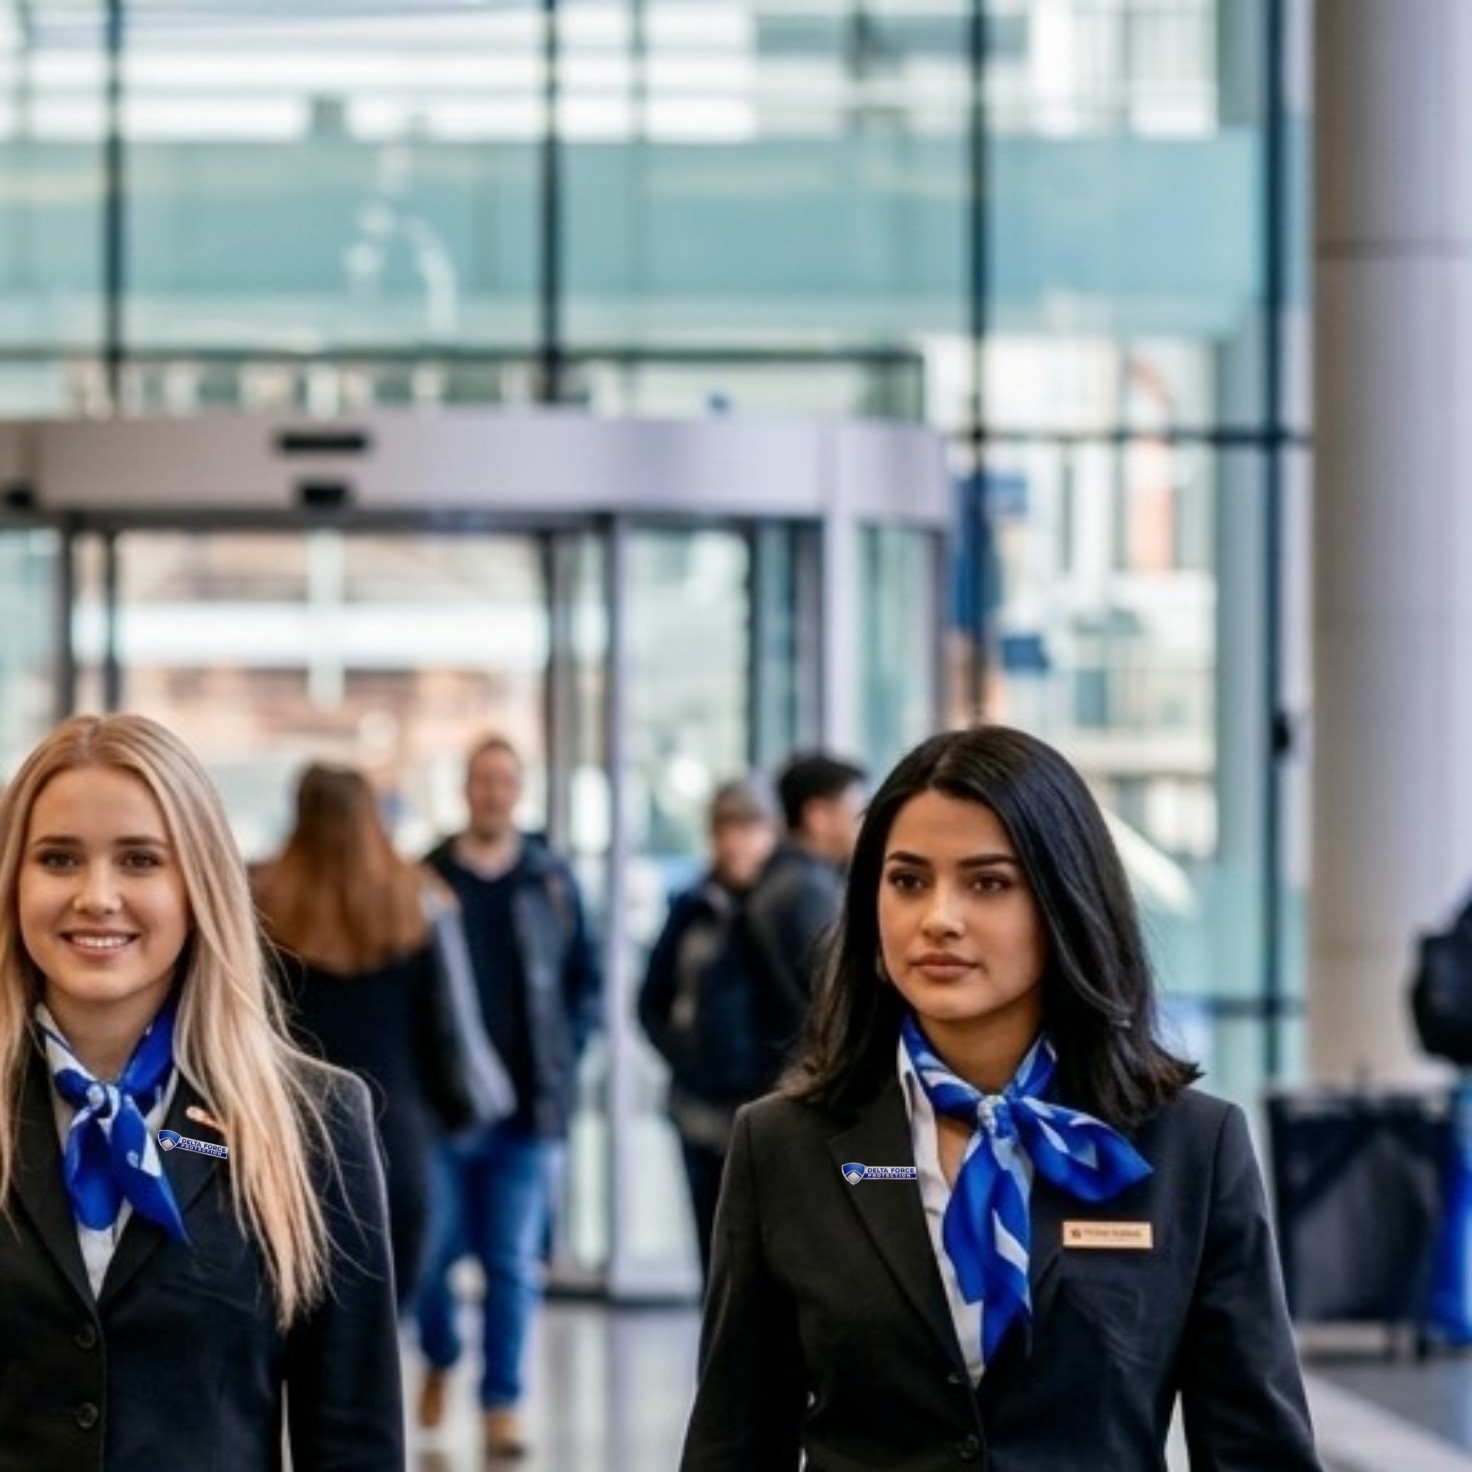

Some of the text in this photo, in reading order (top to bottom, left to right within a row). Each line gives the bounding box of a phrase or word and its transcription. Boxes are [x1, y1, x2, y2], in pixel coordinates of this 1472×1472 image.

[181, 1143, 222, 1156] PROTECTION
[182, 1139, 226, 1152] DELTA FORCE
